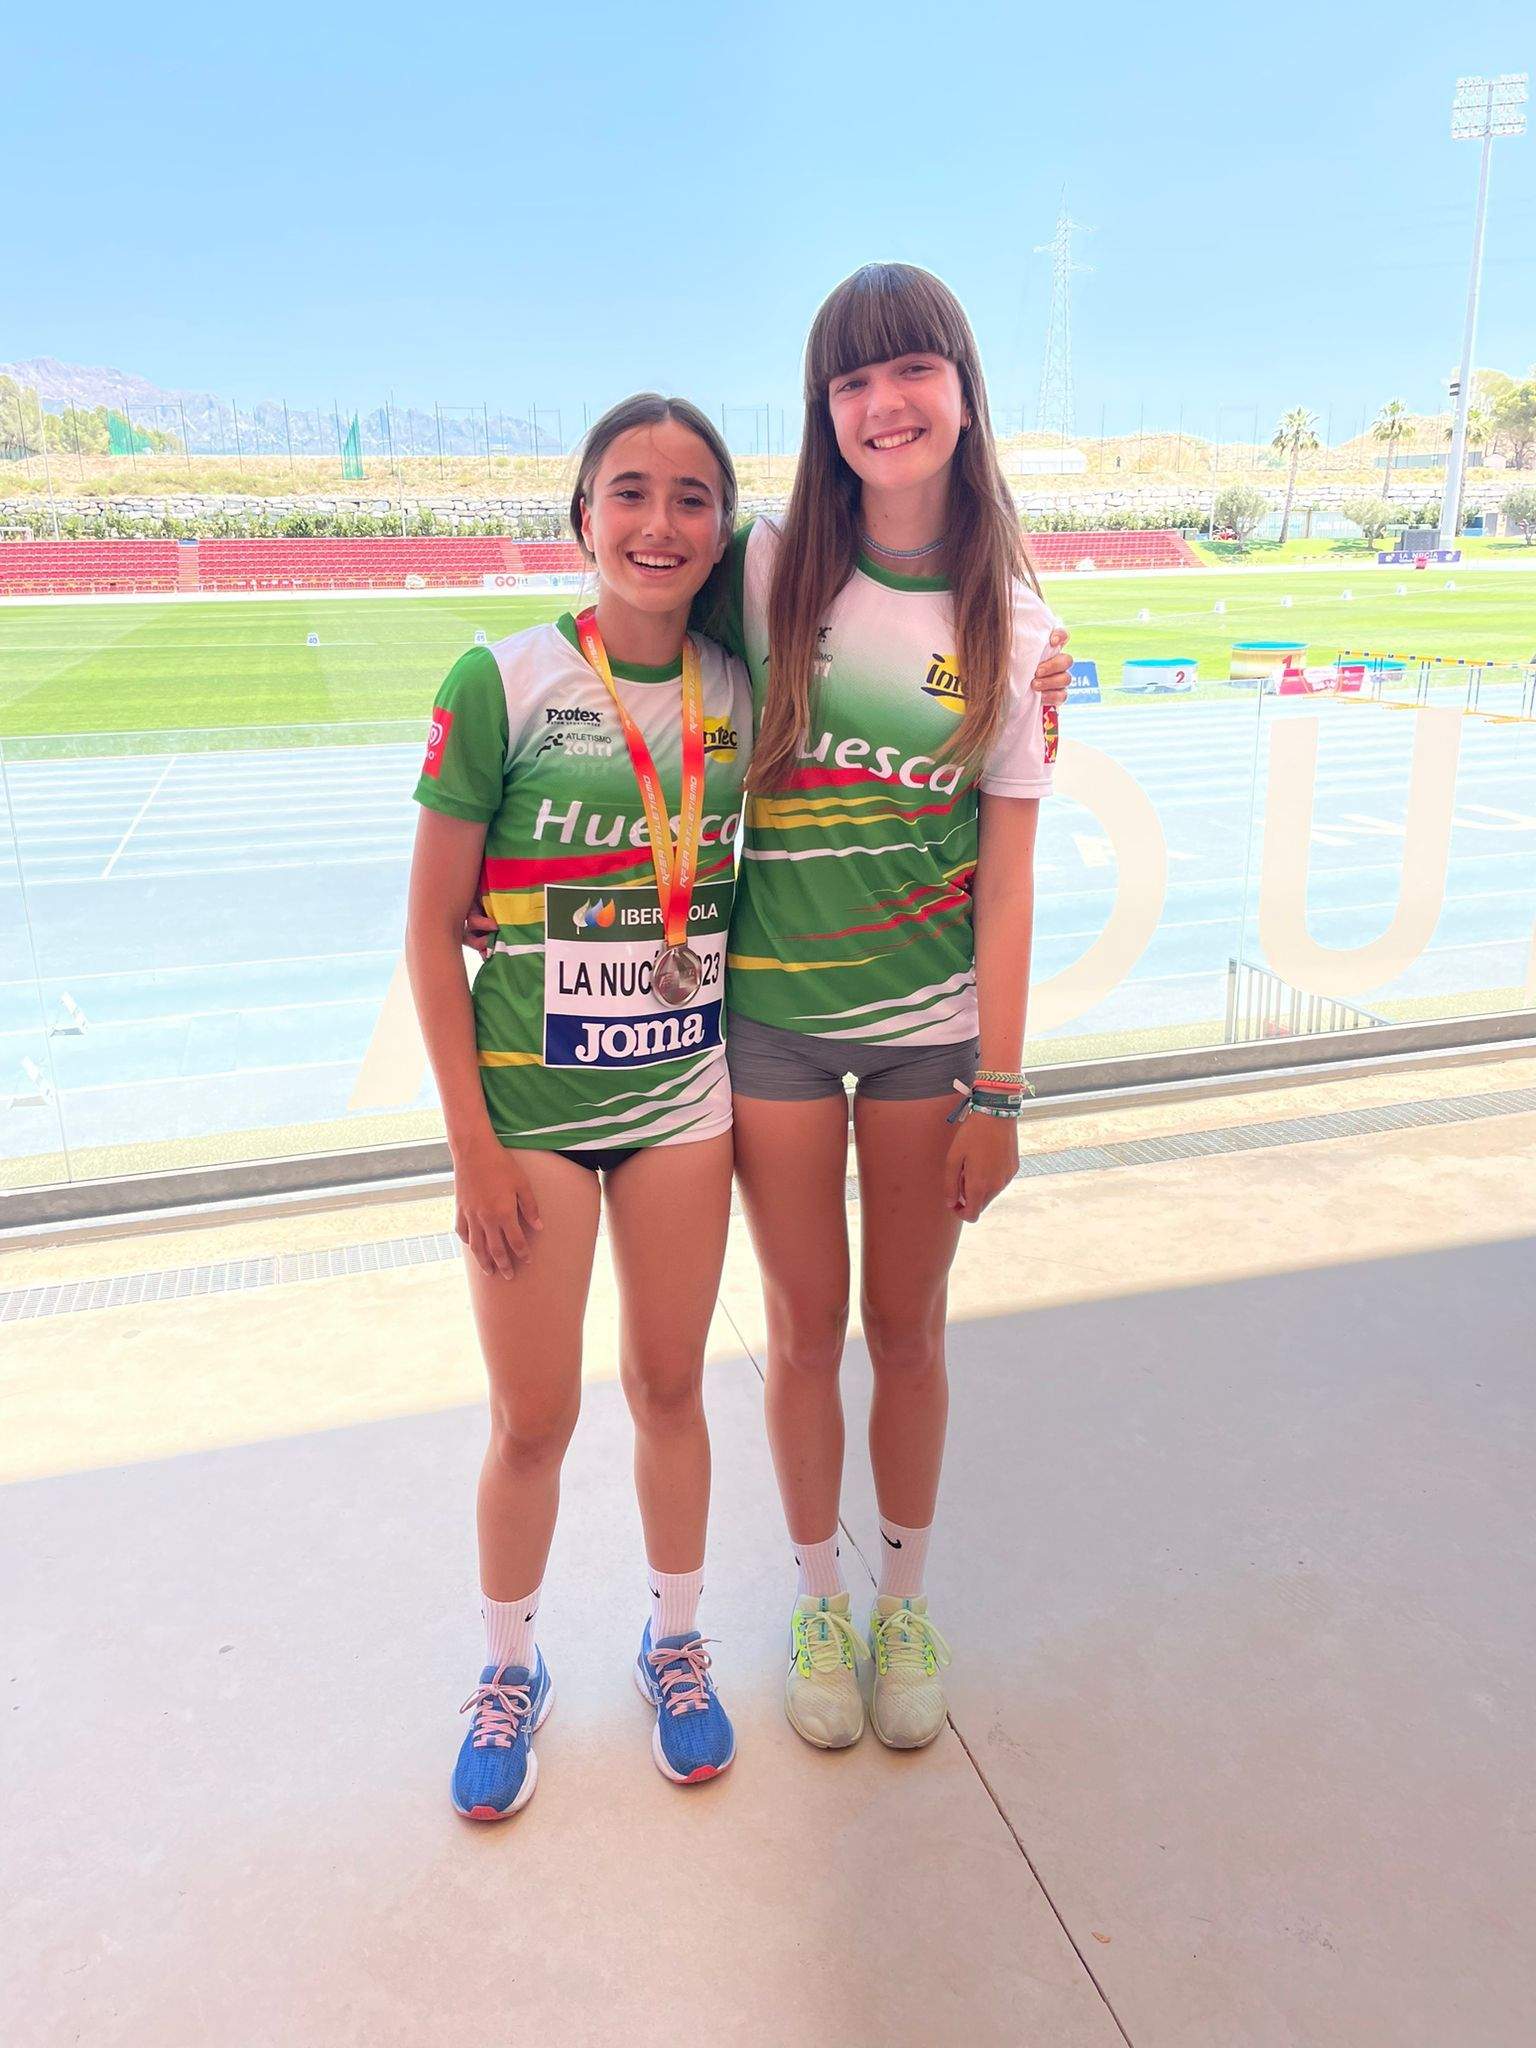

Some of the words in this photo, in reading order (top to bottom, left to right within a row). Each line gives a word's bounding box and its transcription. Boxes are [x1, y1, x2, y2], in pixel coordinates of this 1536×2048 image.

[1071, 675, 1090, 687] CIA
[1175, 670, 1186, 684] 2
[566, 733, 612, 744] ATLETISMO
[703, 726, 738, 747] ntec
[796, 731, 966, 796] uesca
[620, 902, 719, 926] IBEROLA
[558, 960, 593, 996] LA
[600, 950, 659, 997] NUC
[698, 951, 720, 987] 23
